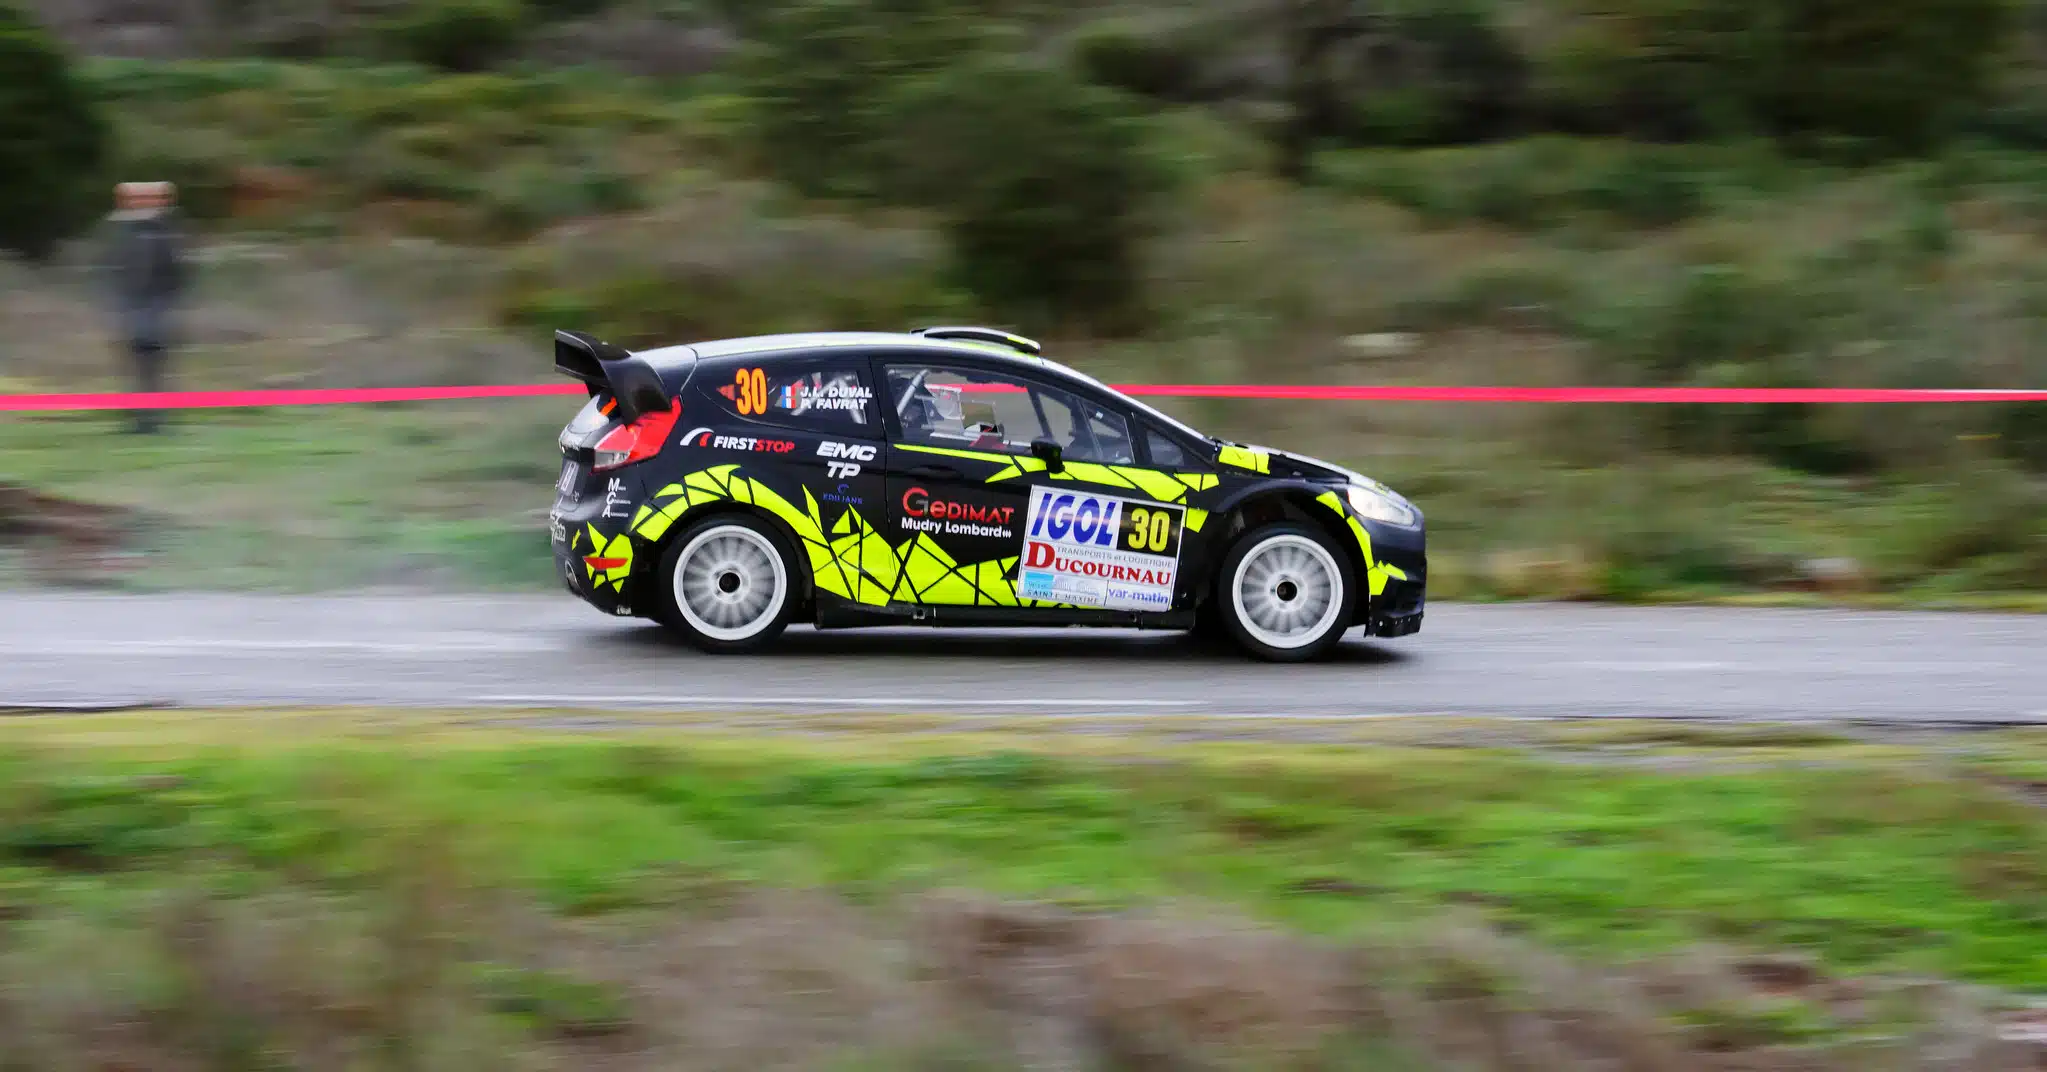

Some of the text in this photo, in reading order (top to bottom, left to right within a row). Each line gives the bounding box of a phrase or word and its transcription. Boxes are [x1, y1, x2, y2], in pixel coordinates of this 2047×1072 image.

[735, 367, 768, 415] 30
[828, 386, 873, 398] DUVAL
[815, 398, 868, 410] FAVRAT
[816, 440, 877, 462] EMC
[826, 461, 862, 480] TP
[901, 516, 1003, 538] Mudry Lombard
[1031, 492, 1171, 553] IGOL 30
[1056, 546, 1112, 562] TRANSPORTS
[1108, 588, 1169, 605] var-matin
